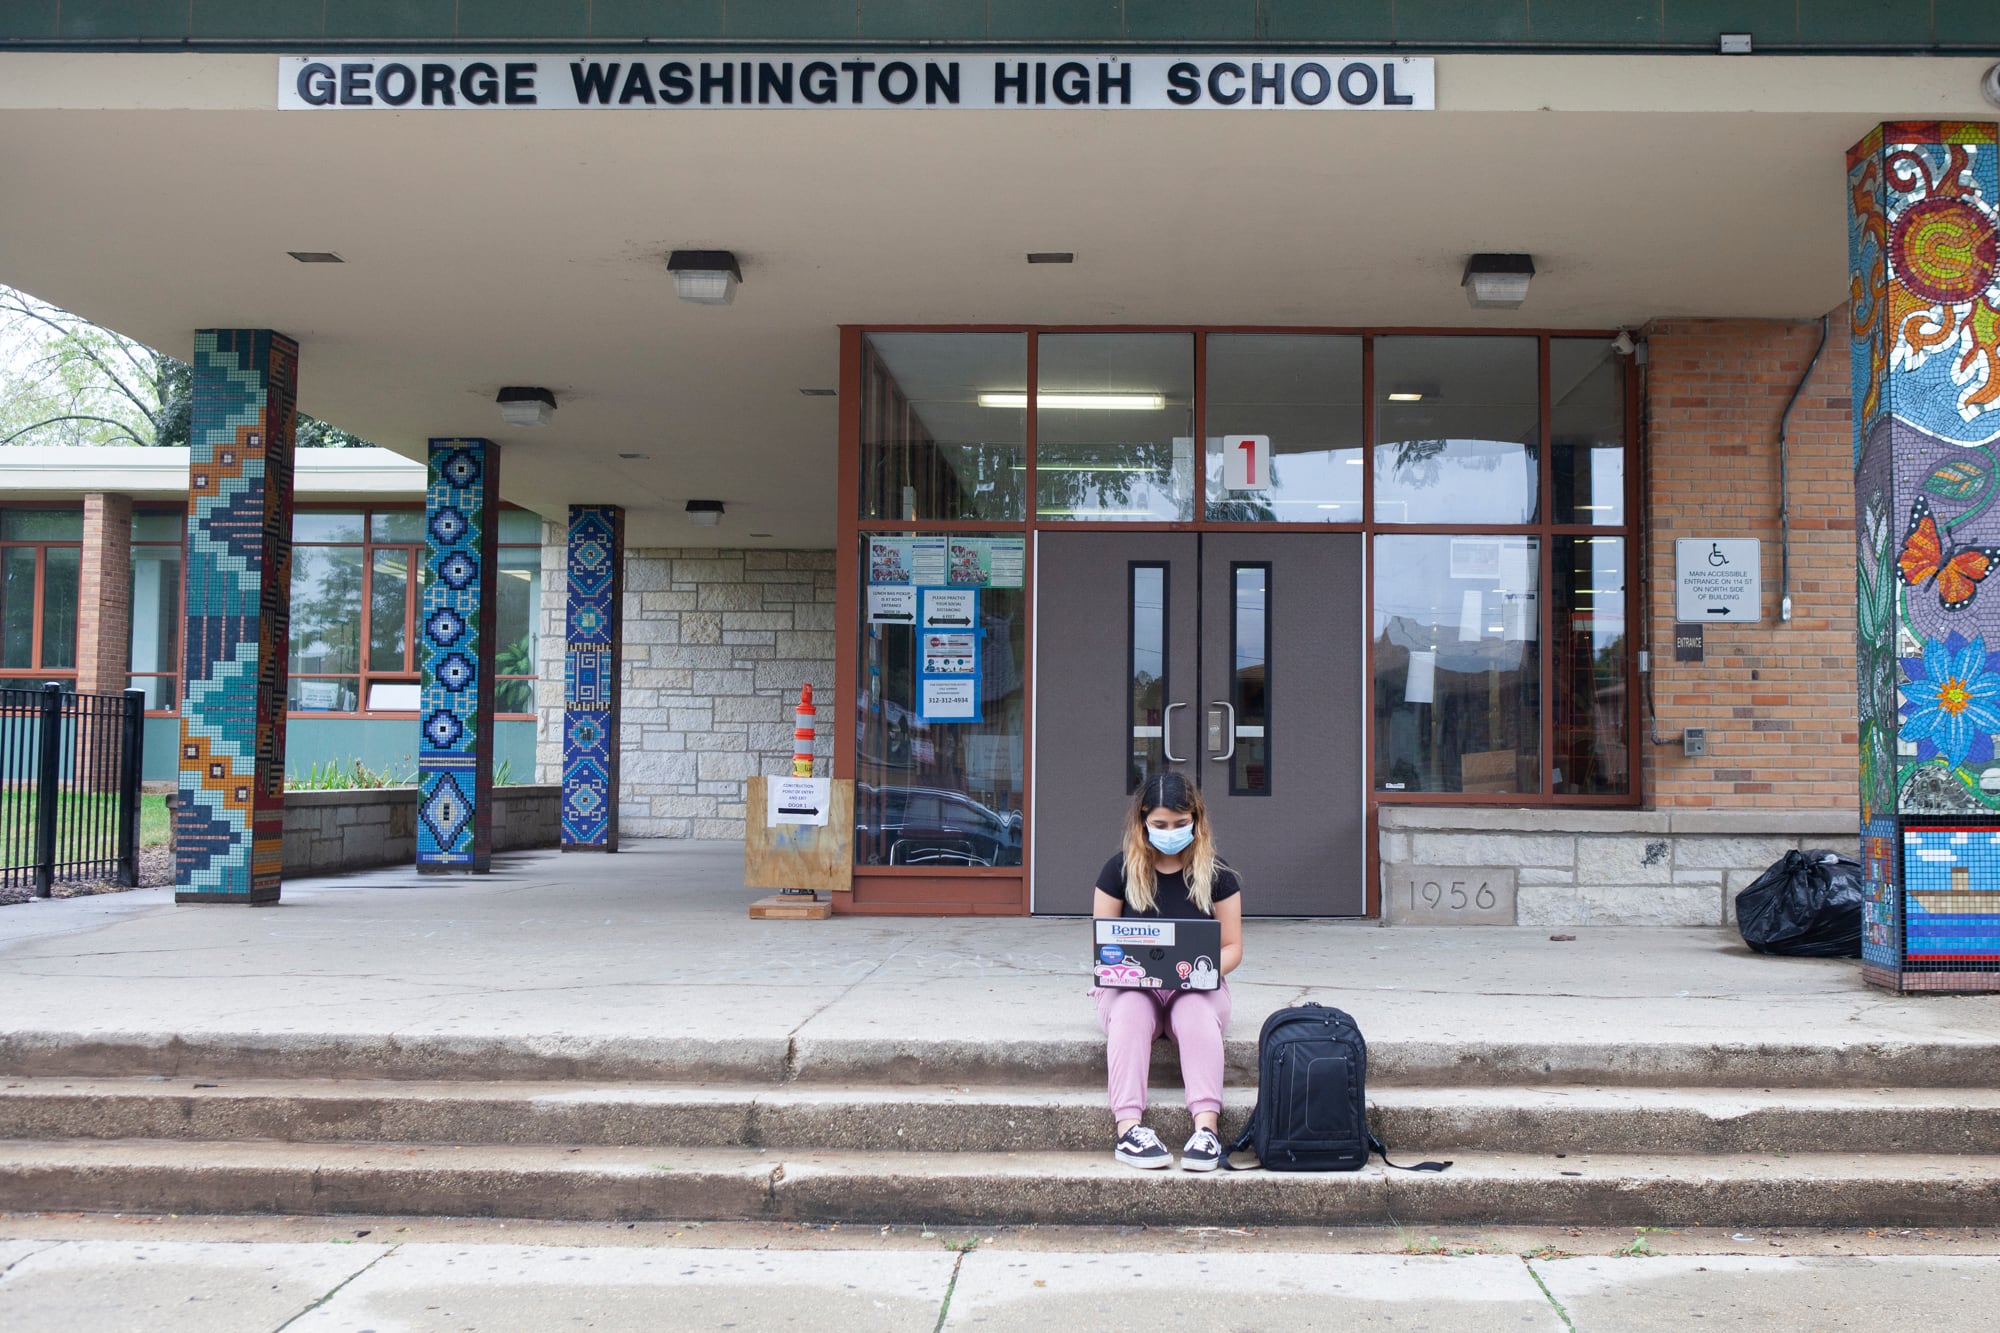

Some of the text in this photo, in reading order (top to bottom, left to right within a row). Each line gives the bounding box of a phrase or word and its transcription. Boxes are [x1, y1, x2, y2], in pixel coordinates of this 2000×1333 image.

[297, 62, 1413, 105] GEORGE WASHINGTON HIGH SCHOOL
[1238, 440, 1256, 485] 1
[1676, 637, 1702, 648] ENTRANCE
[1410, 881, 1496, 910] 1956
[1112, 924, 1160, 936] Bernie
